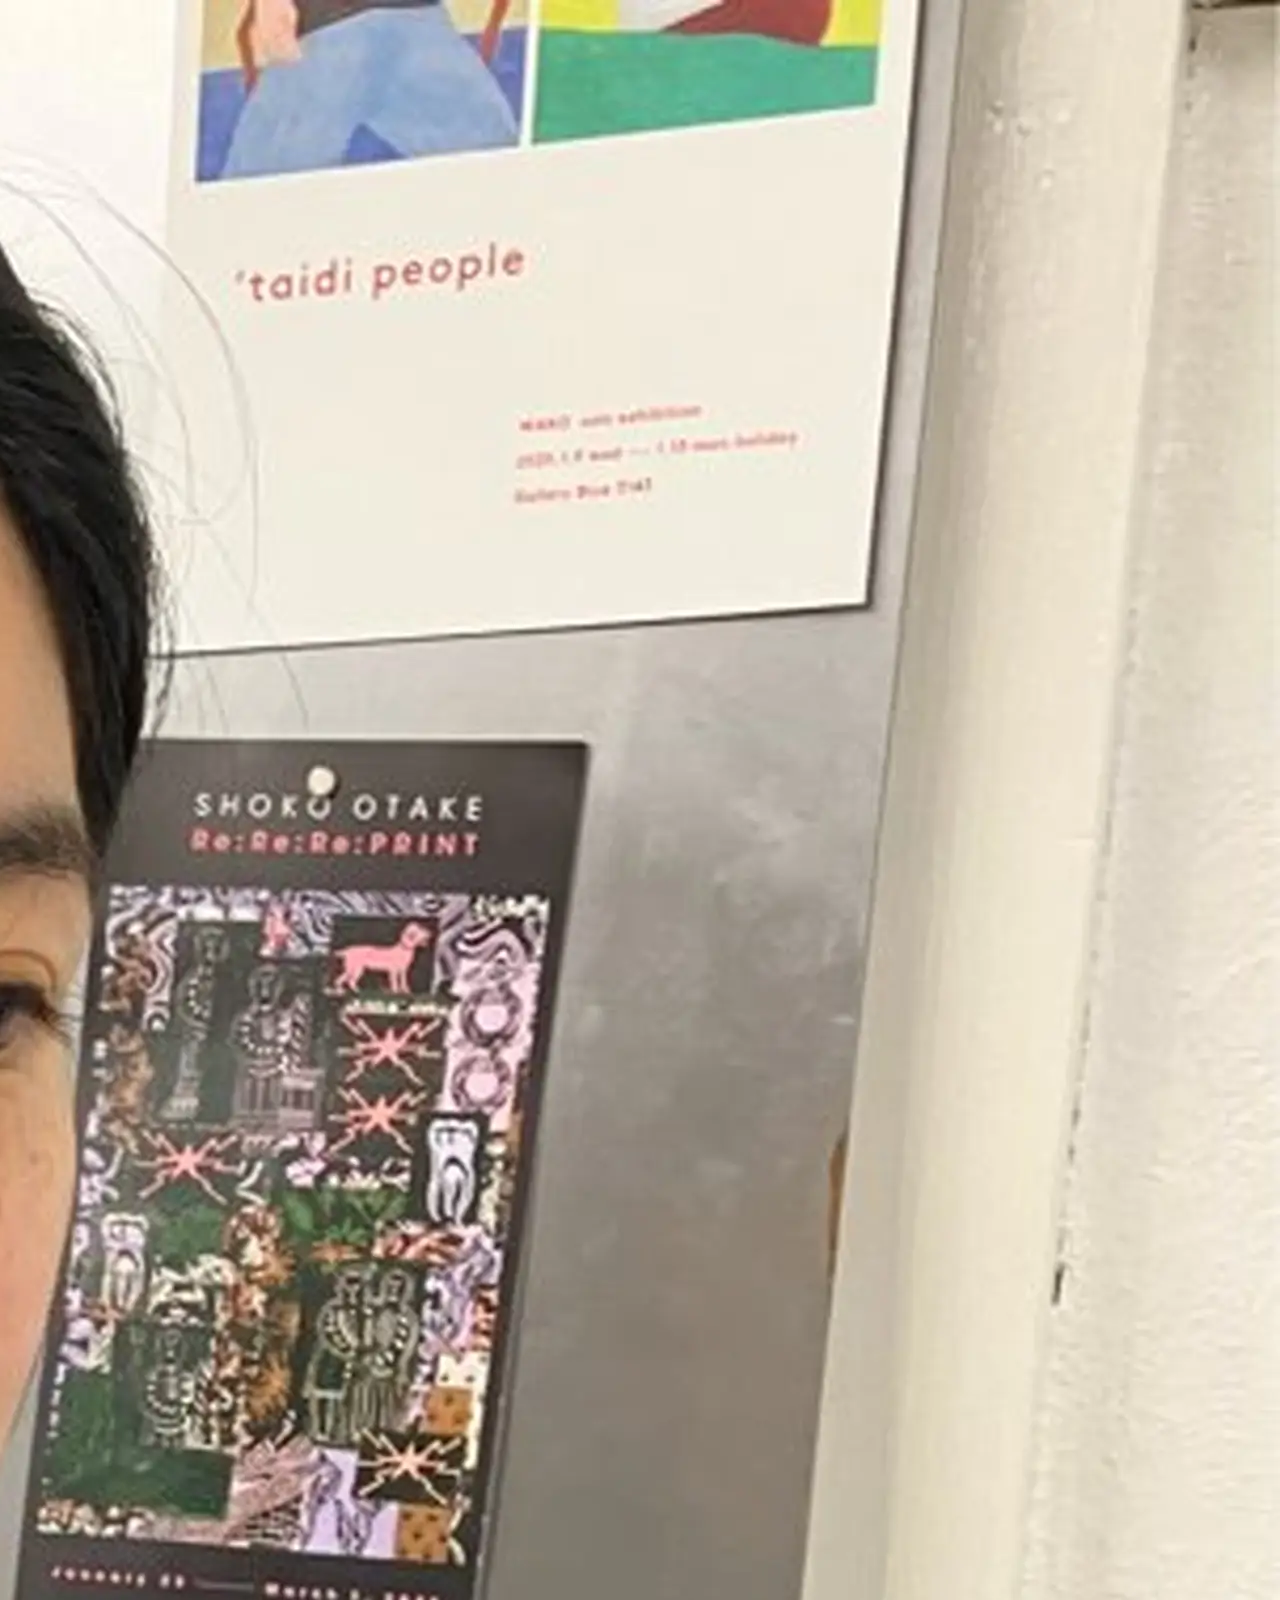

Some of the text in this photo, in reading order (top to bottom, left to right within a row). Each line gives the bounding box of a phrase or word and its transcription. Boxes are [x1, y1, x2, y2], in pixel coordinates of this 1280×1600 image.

[371, 241, 525, 300] people
[193, 792, 483, 821] SHOKO OTAKE
